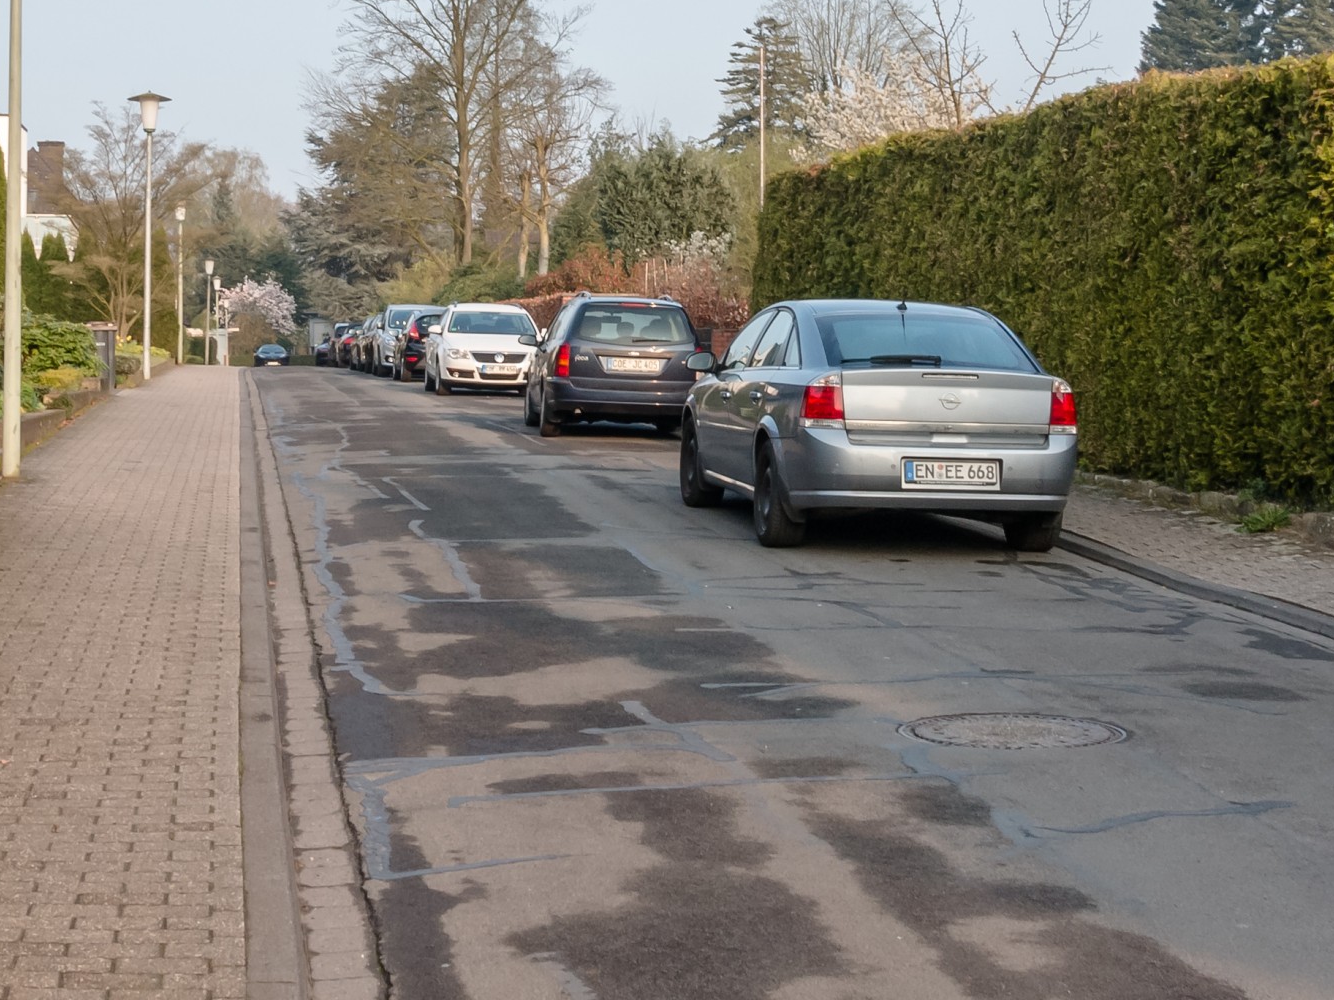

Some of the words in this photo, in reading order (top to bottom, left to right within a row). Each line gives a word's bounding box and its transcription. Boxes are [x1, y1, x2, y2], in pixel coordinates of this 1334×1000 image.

[915, 463, 935, 479] EN
[945, 464, 965, 479] EE
[967, 464, 995, 480] 668
